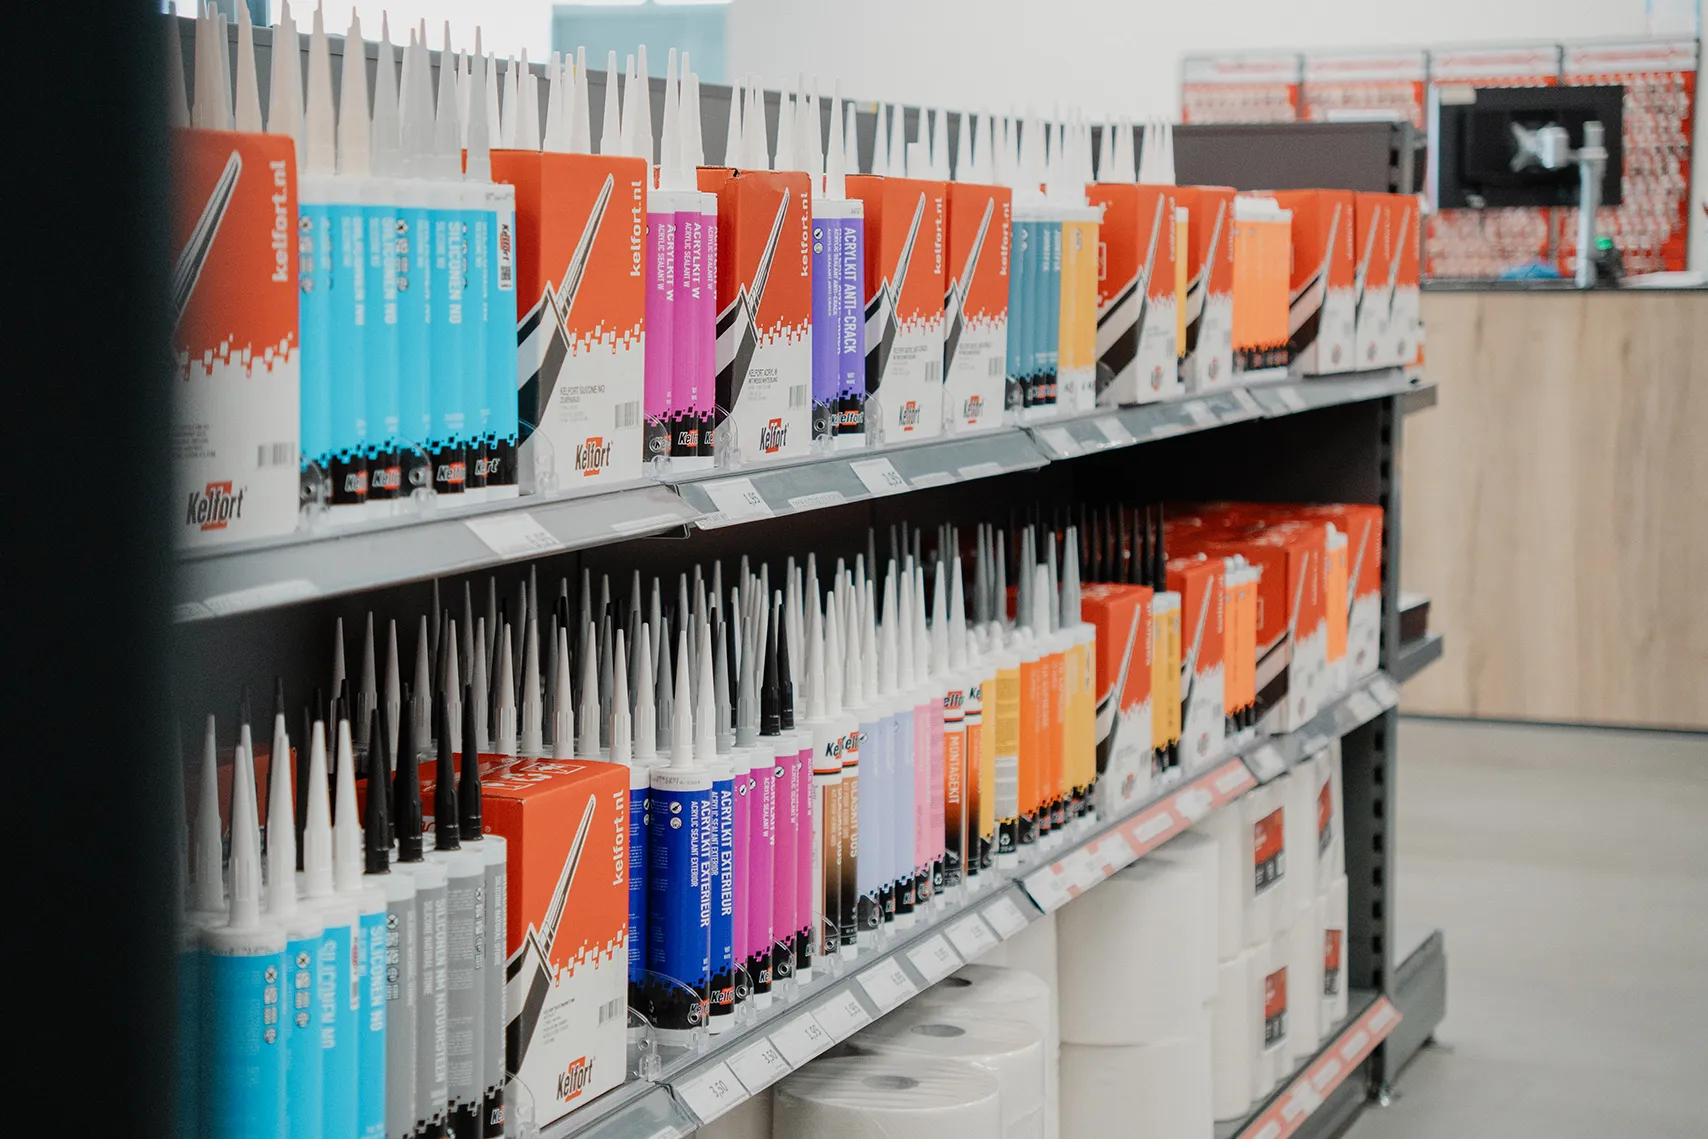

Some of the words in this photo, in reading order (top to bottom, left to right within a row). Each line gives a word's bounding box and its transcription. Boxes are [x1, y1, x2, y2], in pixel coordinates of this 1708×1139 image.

[270, 160, 289, 283] kelfort.nl
[630, 180, 642, 277] kelfort.nl
[657, 224, 665, 252] ACRYLIC
[684, 222, 692, 250] ACRYLIC
[801, 193, 809, 277] kelfort.nl
[934, 197, 943, 275] kelfort.nl
[1000, 203, 1010, 276] kelfort.nl
[448, 221, 462, 300] SILICONEN
[657, 252, 665, 282] SEALANT
[666, 224, 674, 286] ACRYLKIT
[683, 250, 691, 279] SEALANT
[692, 222, 701, 283] ACRYLKIT
[844, 227, 857, 281] ACRYLKIT
[666, 287, 674, 302] W
[683, 280, 690, 288] W
[692, 286, 700, 299] W
[843, 283, 857, 354] ANTI-CRACK
[575, 440, 611, 471] Kelfort
[759, 424, 788, 450] Kelfort
[186, 486, 245, 525] Kelfort
[948, 736, 960, 805] MONTAGEKIT
[612, 789, 624, 886] kelfort.nl
[691, 801, 699, 828] ACRYLIC
[701, 800, 711, 857] ACRYLKIT
[711, 818, 719, 846] SEALANT
[721, 790, 732, 847] ACRYLKIT
[711, 846, 719, 876] EXTERIOR
[721, 850, 733, 916] EXTERIEUR
[700, 861, 711, 927] EXTERIEUR
[435, 898, 446, 967] SILICONEN
[370, 925, 384, 1007] SILICONEN
[434, 993, 446, 1083] NATUURSTEEN
[762, 1049, 778, 1064] 3,50
[805, 1024, 822, 1041] 1,95
[556, 1060, 594, 1101] Kelfort
[709, 1080, 729, 1098] 3,50
